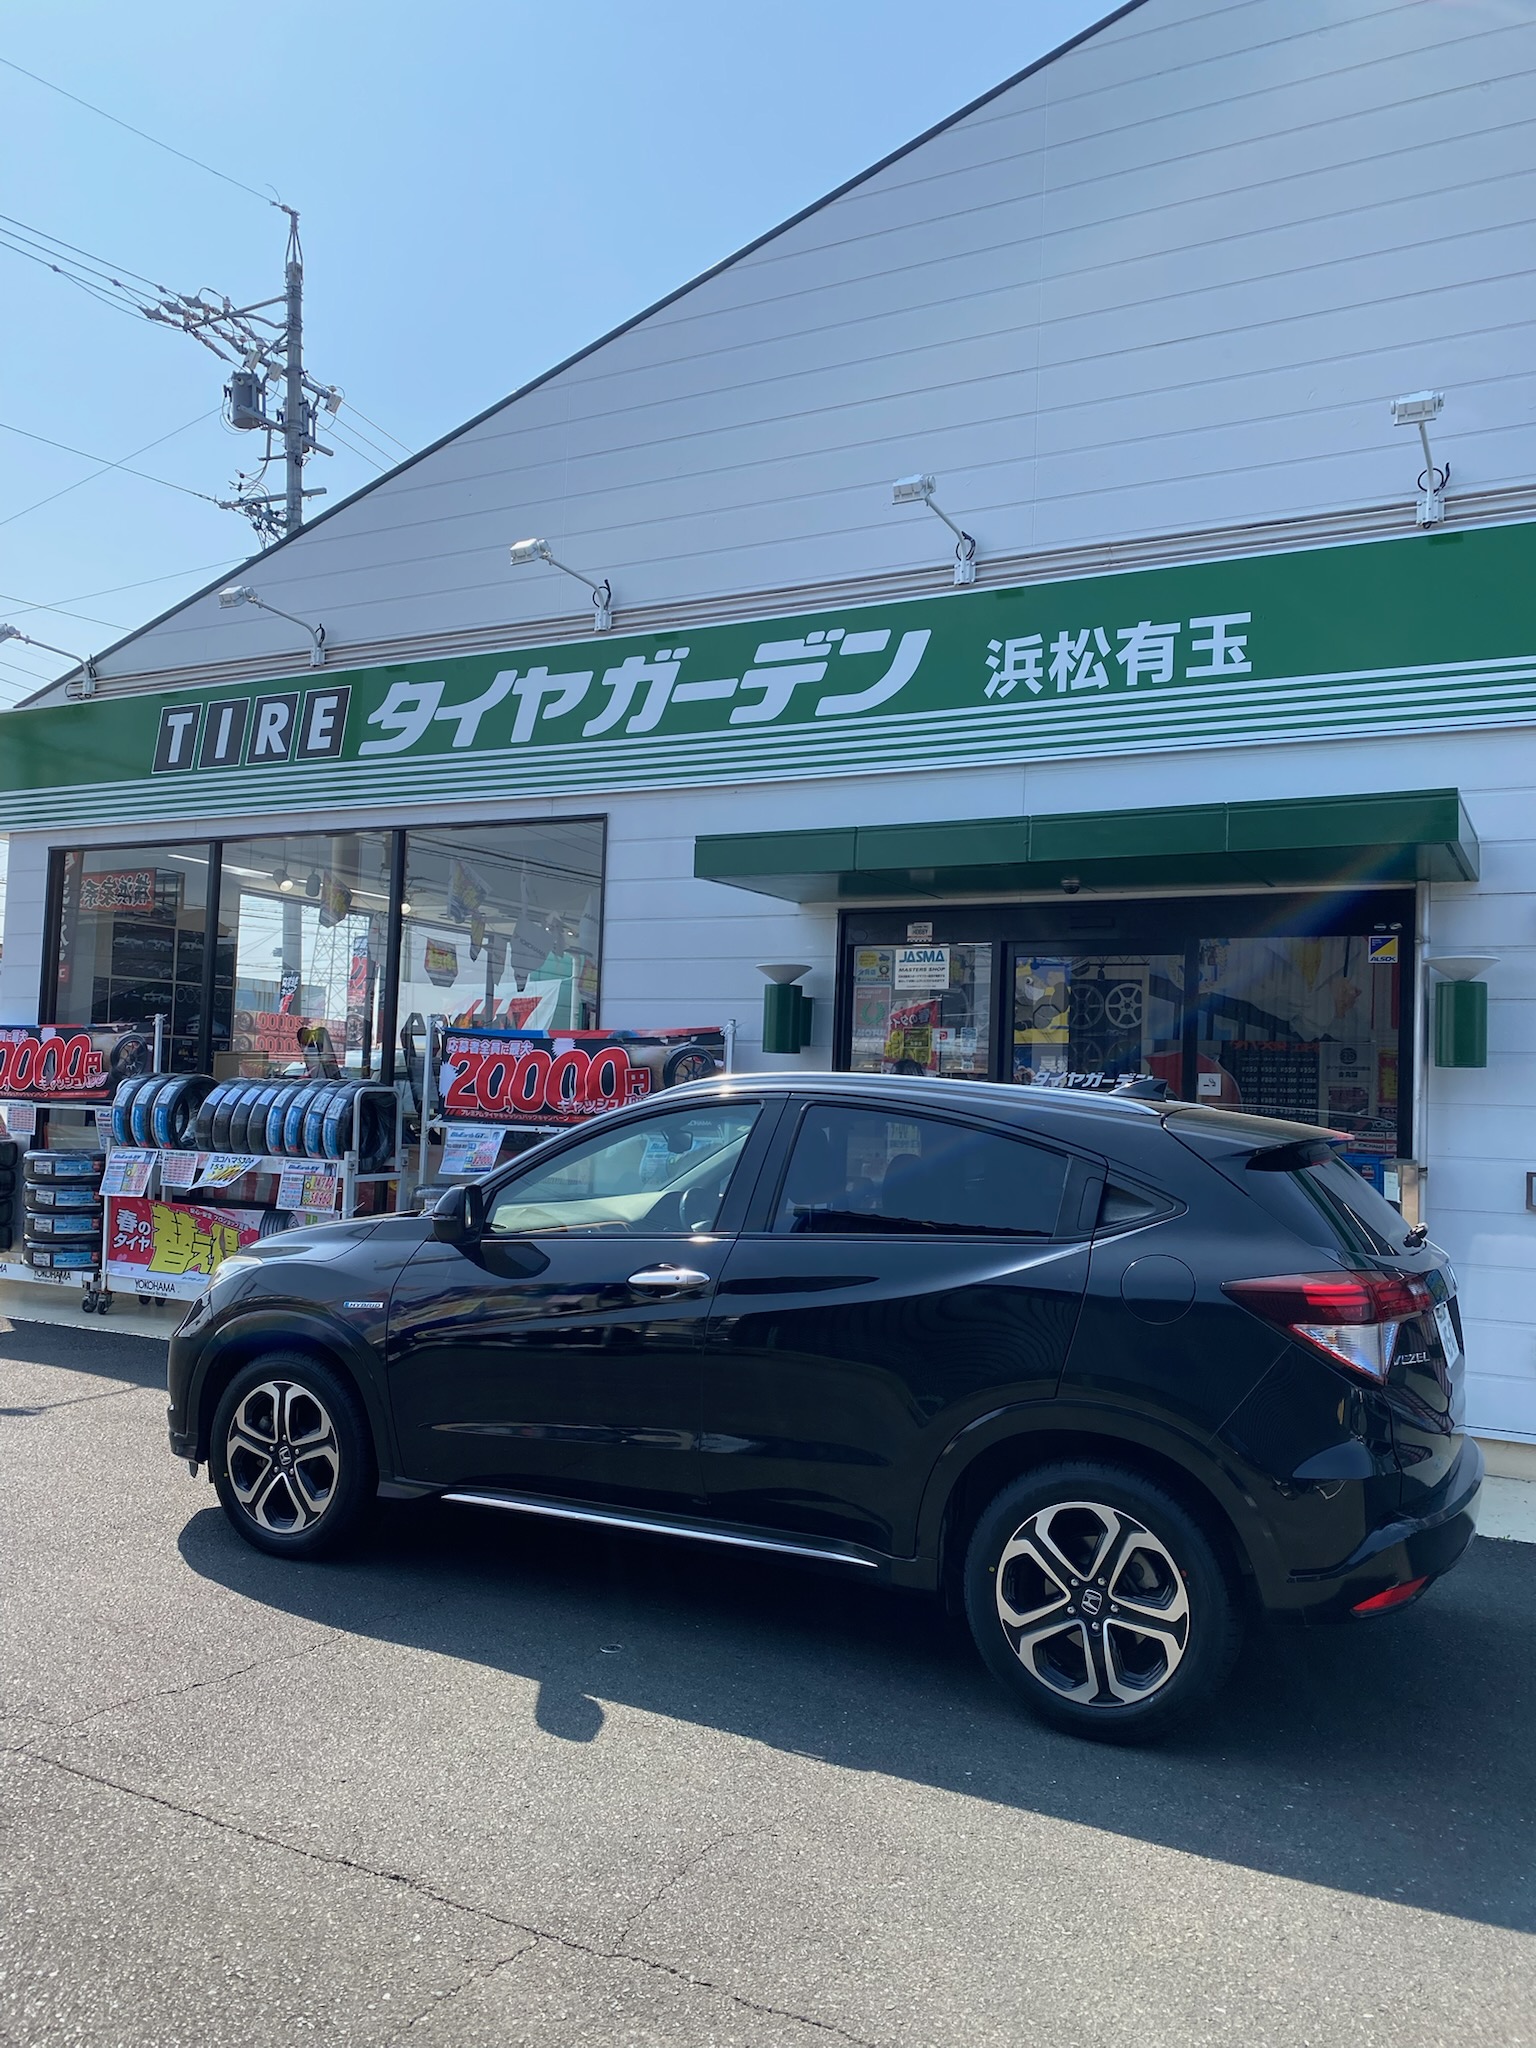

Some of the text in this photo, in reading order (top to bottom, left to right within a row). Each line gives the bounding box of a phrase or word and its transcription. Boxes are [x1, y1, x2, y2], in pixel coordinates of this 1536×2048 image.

[164, 611, 1253, 765] TIRE タイヤガーデン 浜松有玉
[899, 950, 945, 963] JASMA
[447, 1038, 533, 1056] 応募者全員に最大
[116, 1208, 151, 1236] 春の
[113, 1233, 151, 1253] タイヤ
[134, 1279, 176, 1293] YOKOHAMA
[1393, 1351, 1431, 1367] VEZEL
